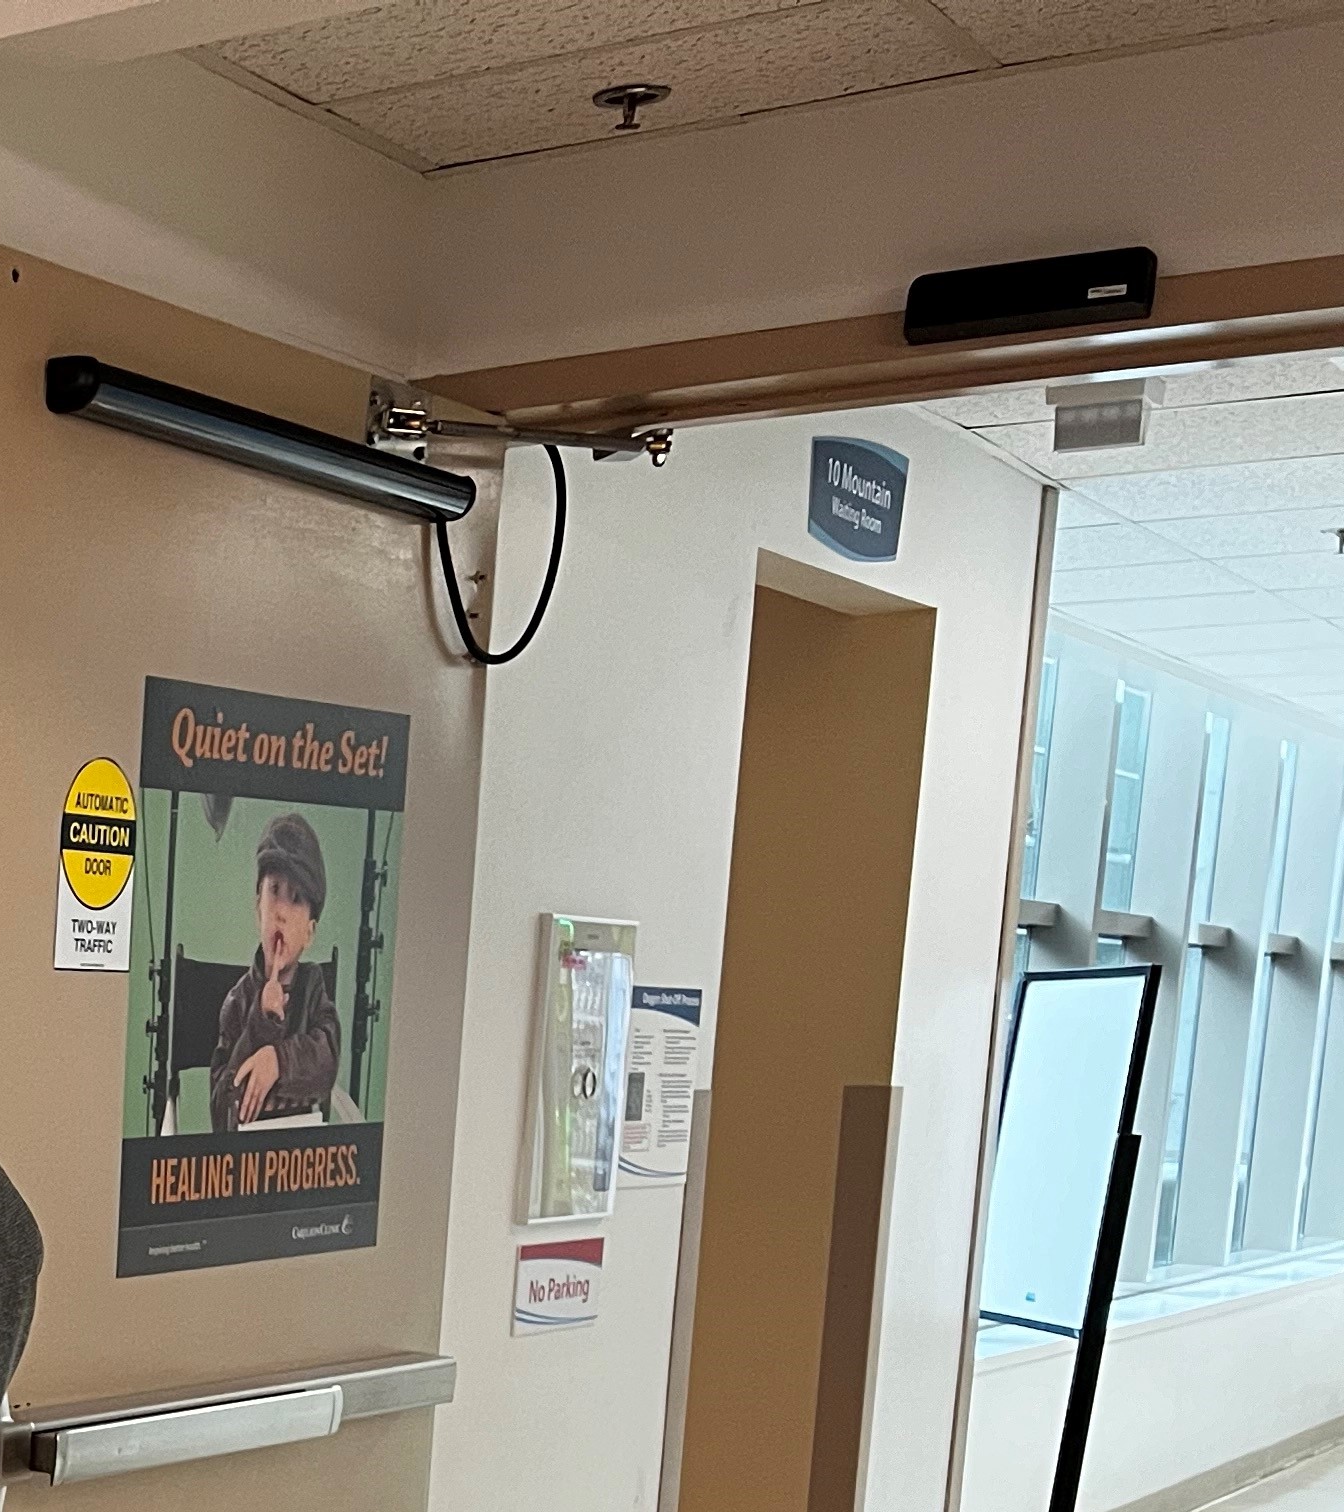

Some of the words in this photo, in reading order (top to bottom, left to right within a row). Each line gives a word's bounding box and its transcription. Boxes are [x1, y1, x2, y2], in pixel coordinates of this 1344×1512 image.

[828, 458, 840, 486] 10
[841, 463, 891, 509] Mountain
[832, 496, 860, 530] Waiting
[861, 509, 882, 533] Room
[171, 707, 250, 768] Quiet
[253, 733, 286, 767] on
[292, 722, 334, 772] the
[338, 730, 389, 778] Set!
[75, 792, 129, 814] AUTOMATIC
[70, 822, 130, 848] CAUTION
[84, 858, 112, 876] DOOR
[71, 918, 117, 936] TWO-WAY
[74, 938, 114, 954] TRAFFIC
[151, 1153, 234, 1205] HEALING
[240, 1152, 260, 1196] IN
[264, 1144, 361, 1194] PROGRESS.
[529, 1280, 545, 1303] No
[548, 1274, 590, 1303] Parking
